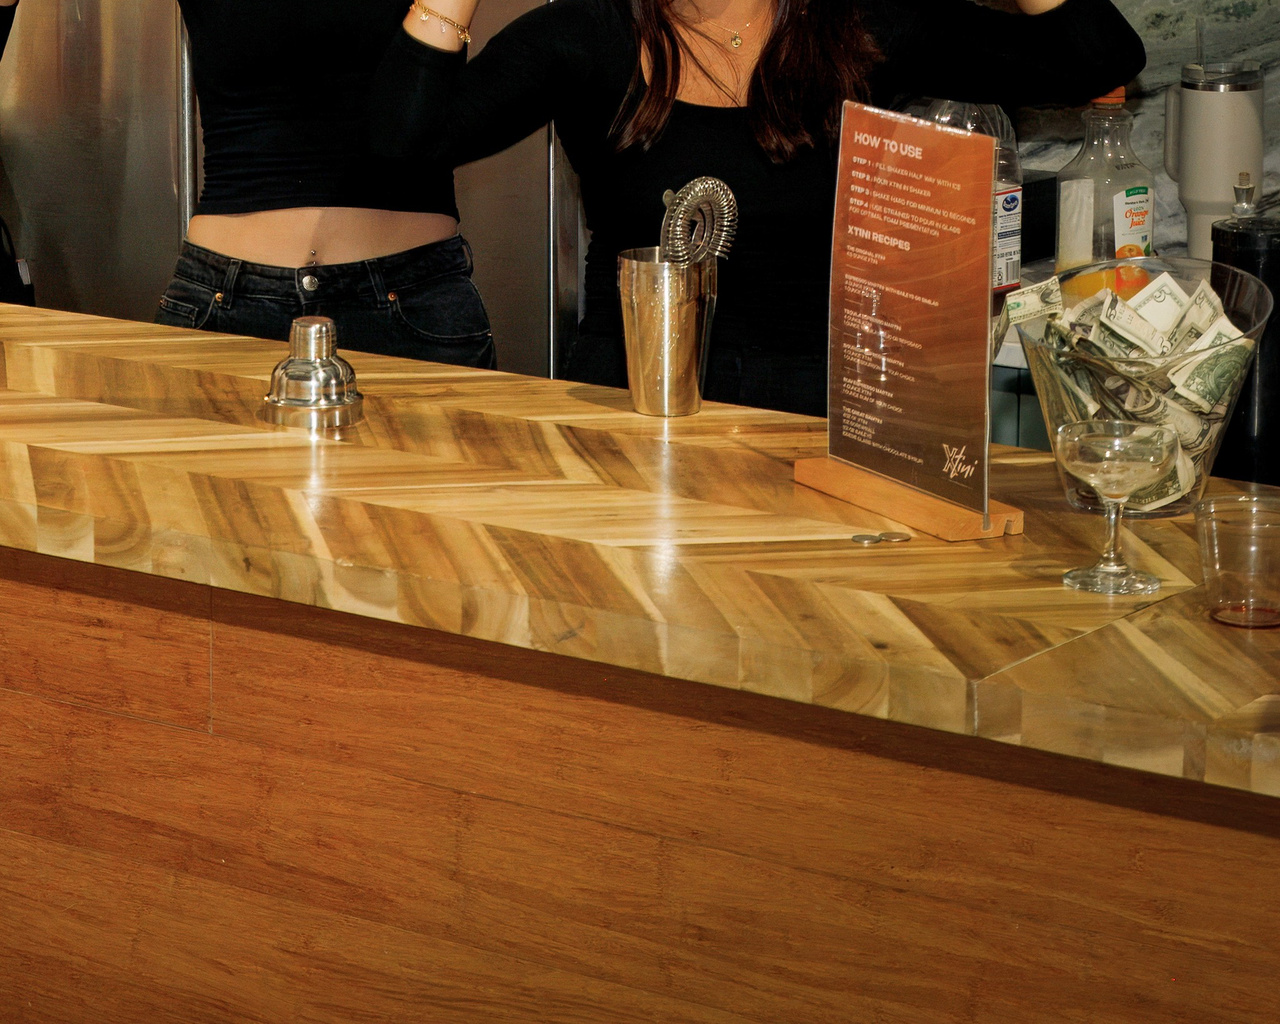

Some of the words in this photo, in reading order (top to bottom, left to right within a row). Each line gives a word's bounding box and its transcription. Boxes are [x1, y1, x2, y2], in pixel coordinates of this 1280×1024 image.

[854, 131, 880, 149] HOW
[883, 139, 898, 153] TO
[900, 143, 922, 160] USE
[852, 156, 867, 166] STEP
[887, 165, 907, 177] SHAKER
[908, 170, 922, 180] HALF
[937, 178, 951, 188] WITH
[852, 170, 865, 180] STEP
[873, 176, 888, 186] POUR
[909, 185, 931, 198] SHAKER
[850, 184, 865, 195] STEP
[906, 199, 917, 209] FOR
[949, 211, 976, 225] SECONDS
[850, 197, 864, 208] STEP
[911, 214, 918, 223] TO
[919, 216, 934, 227] POUR
[942, 223, 960, 235] GLASS
[1124, 208, 1148, 219] Orange
[884, 215, 898, 226] FOAM
[1129, 219, 1145, 229] Juice
[848, 225, 871, 240] XTINI
[872, 232, 910, 252] RECIPES
[942, 444, 978, 479] Xtini
